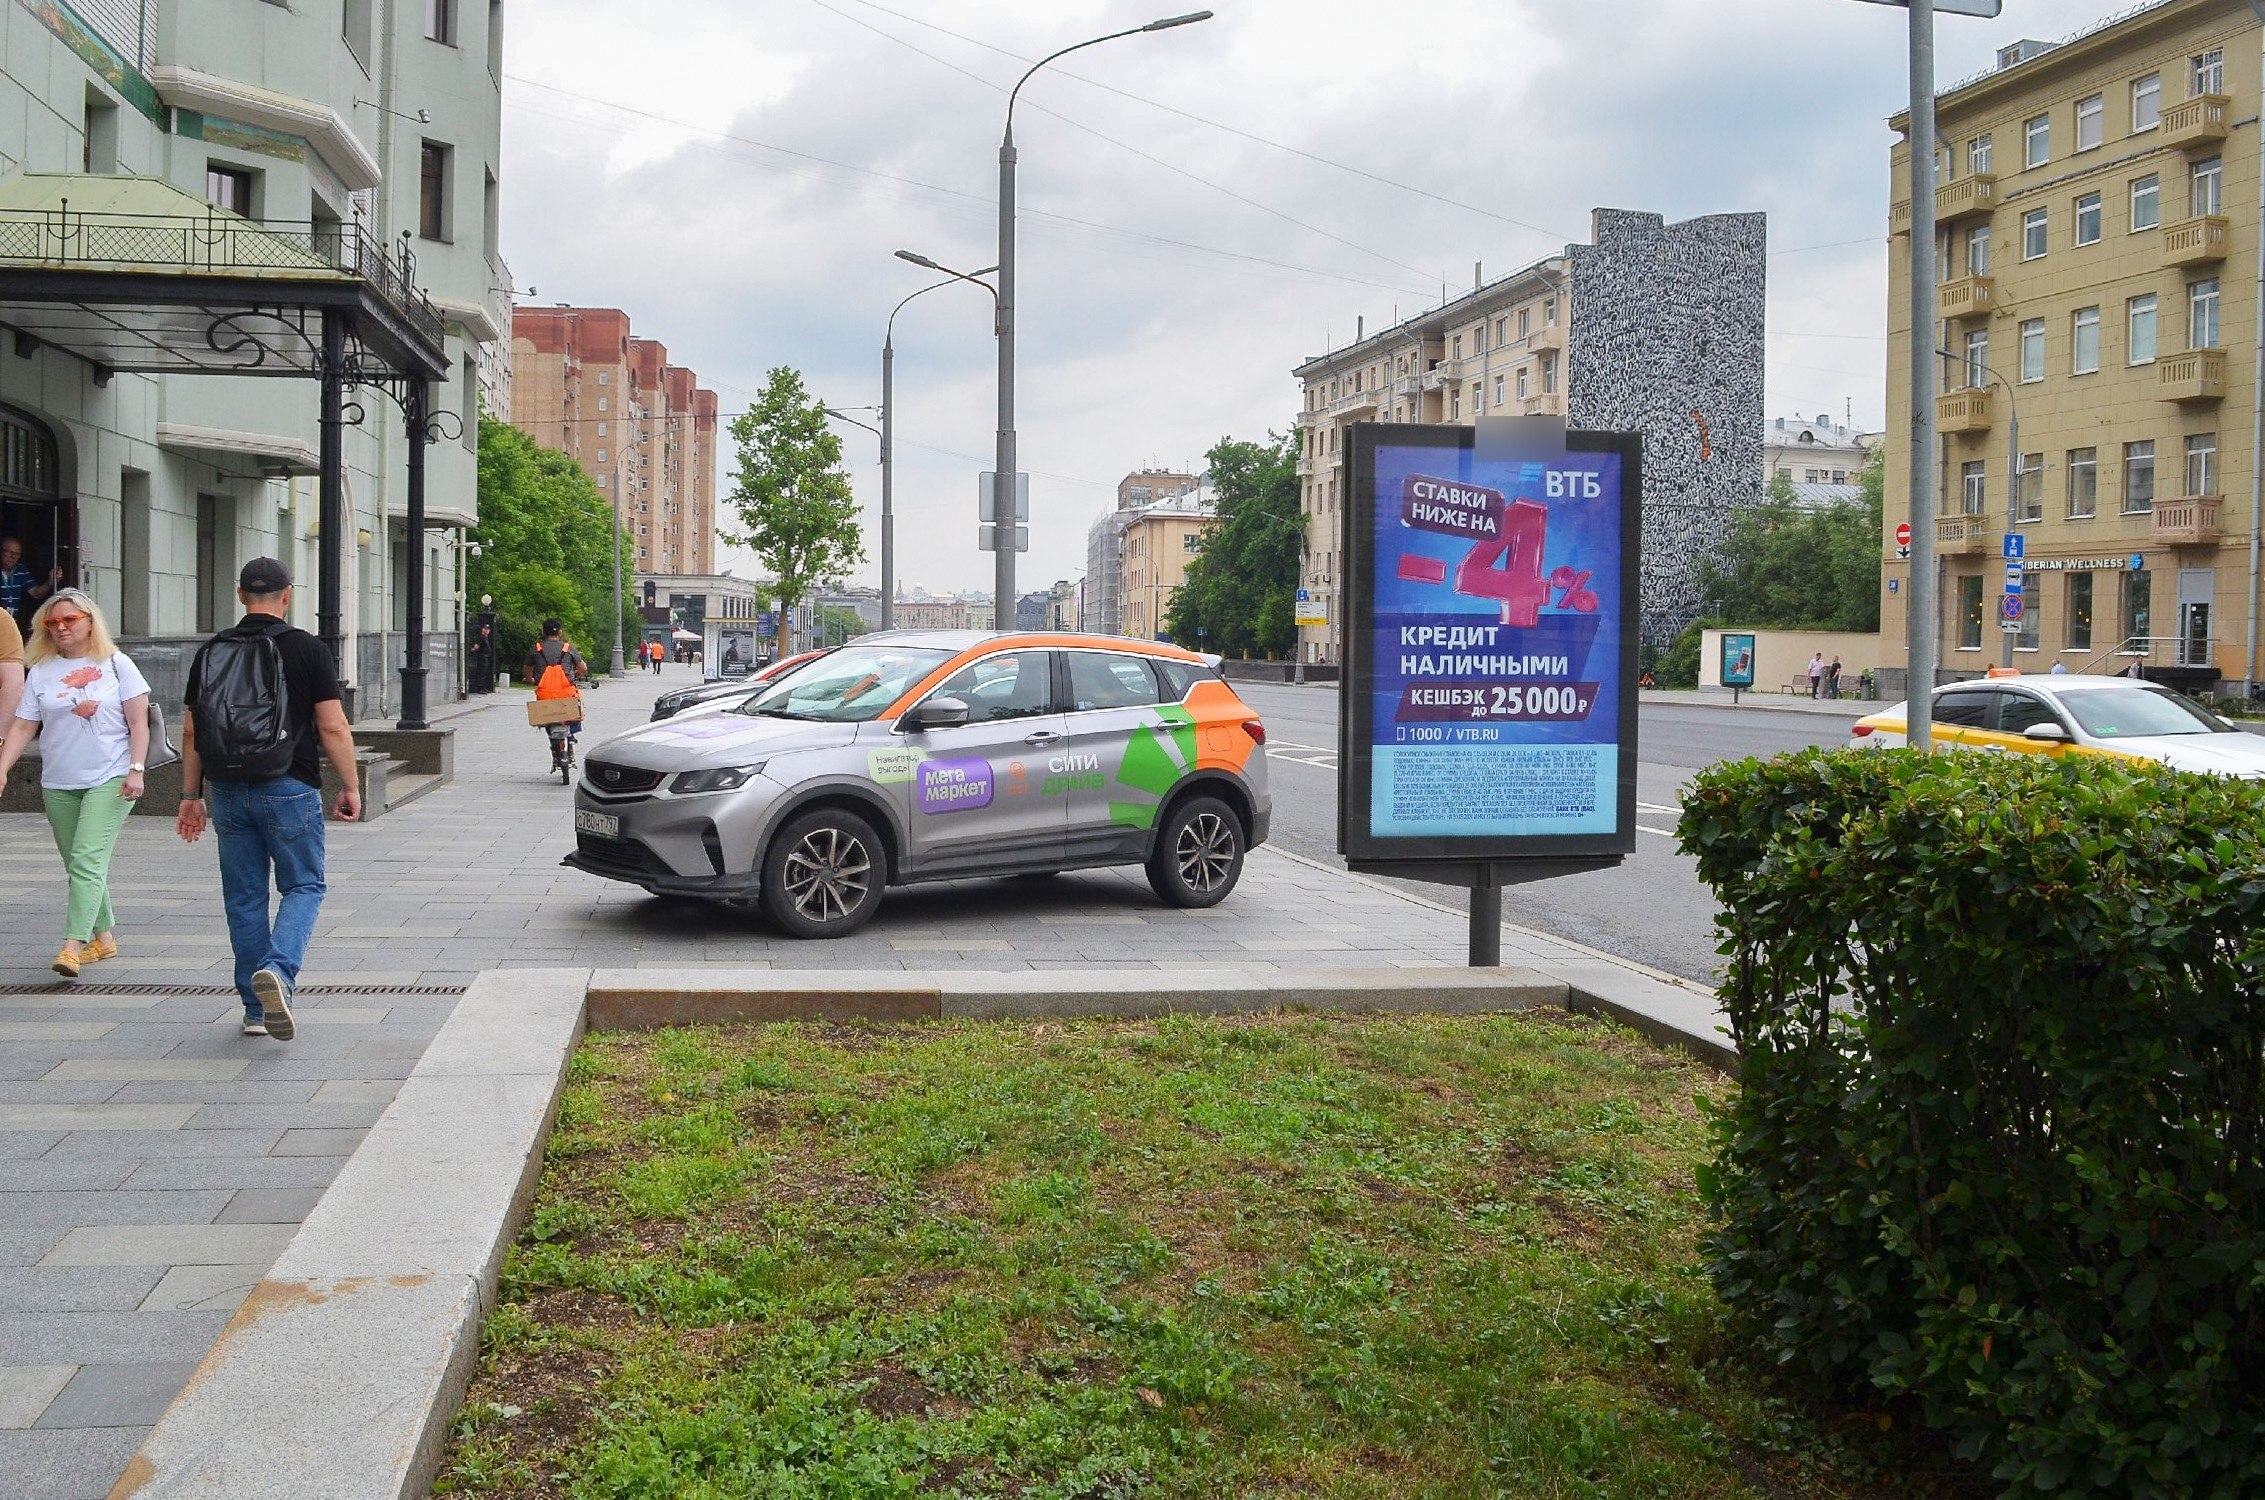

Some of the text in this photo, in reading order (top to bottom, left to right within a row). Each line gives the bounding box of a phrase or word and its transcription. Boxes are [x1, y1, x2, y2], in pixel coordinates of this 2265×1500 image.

[1546, 470, 1601, 499] ВТБ
[1412, 481, 1487, 511] СТАВКИ
[1411, 502, 1497, 534] НИЖЕ НА
[1400, 626, 1499, 650] КРЕДИТ
[1400, 655, 1568, 676] НАЛИЧНЫМИ
[1411, 689, 1486, 705] КЕШБЭК
[1409, 727, 1442, 741] 1000
[1456, 728, 1499, 741] VTB.RU
[875, 754, 920, 765] Навигатор
[877, 764, 910, 774] выгоды
[1048, 753, 1098, 773] СИТИ
[925, 780, 987, 802] маркет
